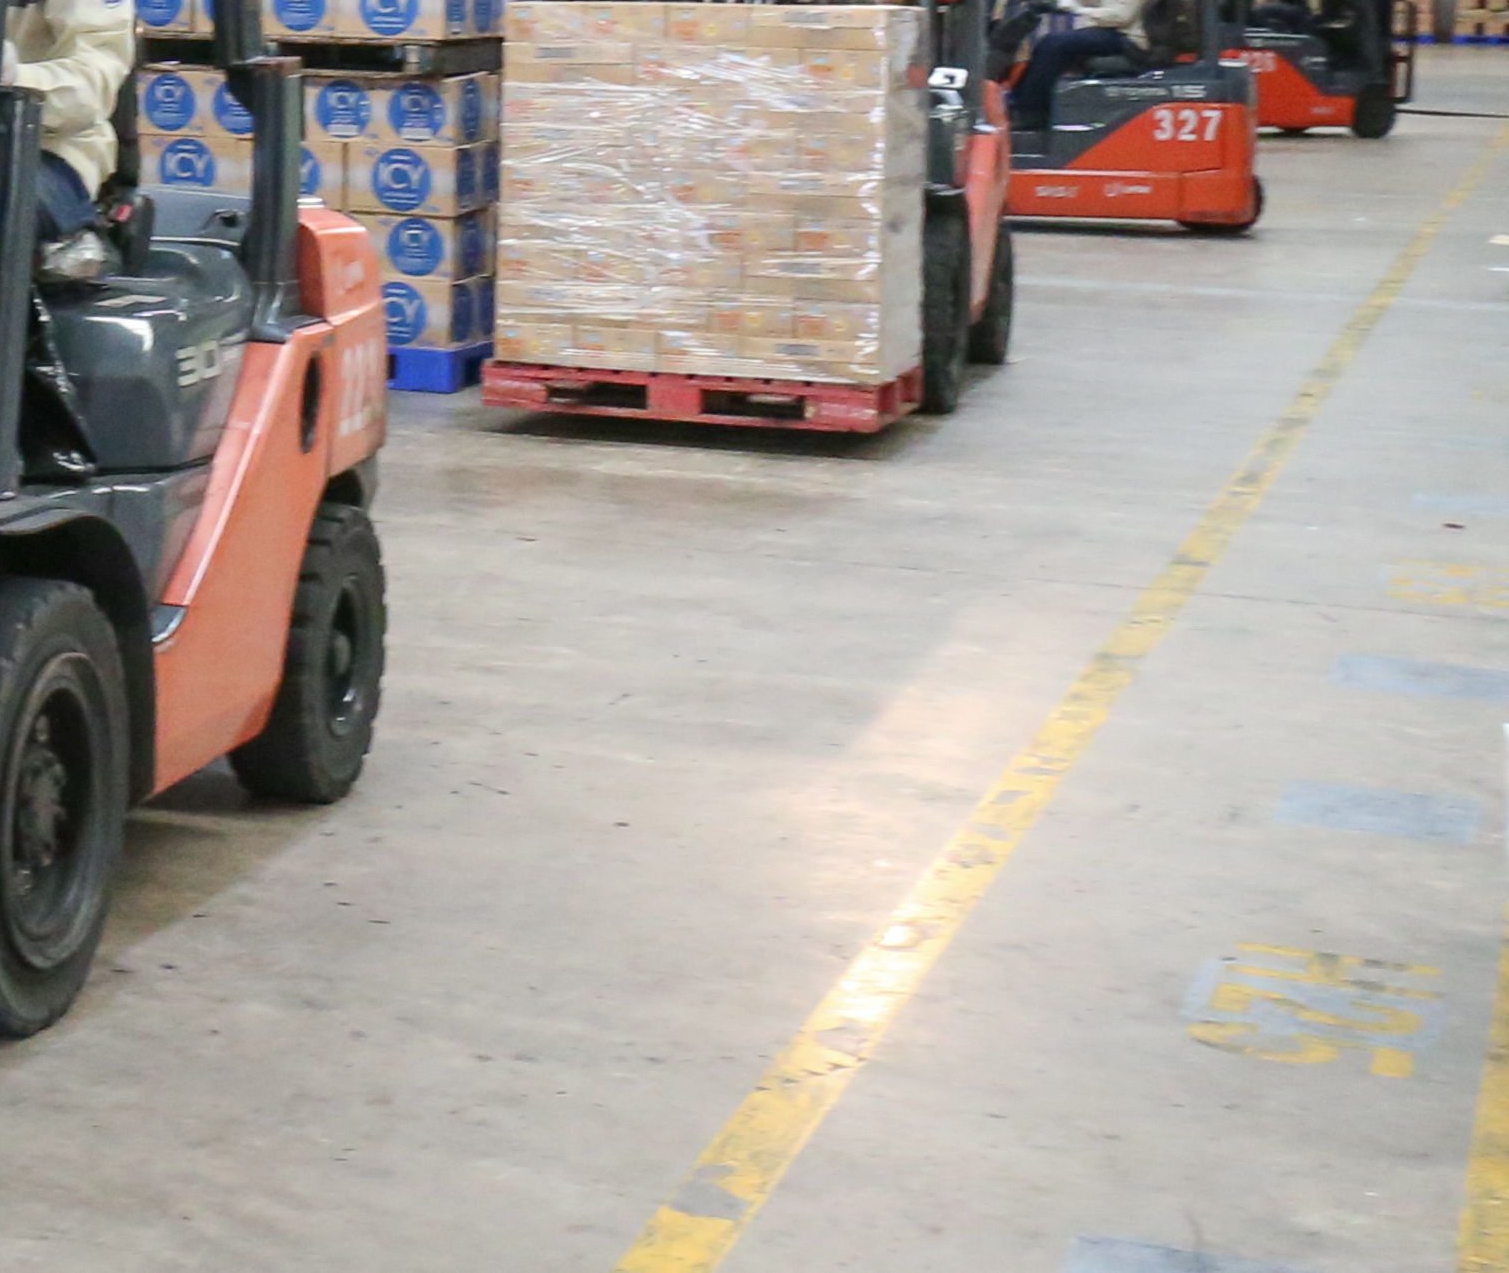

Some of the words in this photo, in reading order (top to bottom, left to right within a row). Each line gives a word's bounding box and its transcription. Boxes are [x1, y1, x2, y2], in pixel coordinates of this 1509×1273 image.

[1153, 109, 1224, 141] 327
[384, 301, 423, 325] CY
[177, 340, 221, 388] 30
[1186, 942, 1444, 1080] H25
